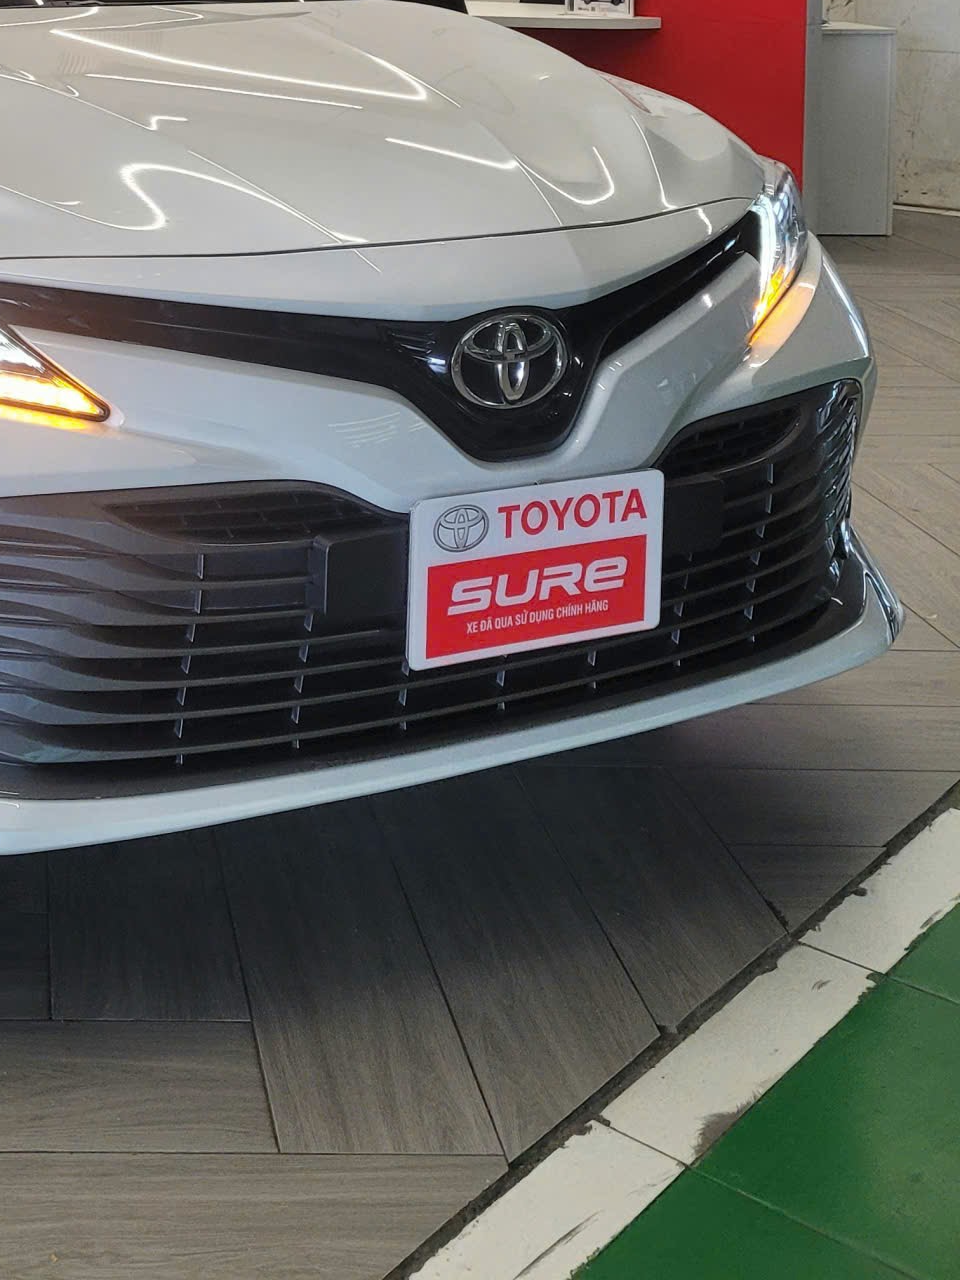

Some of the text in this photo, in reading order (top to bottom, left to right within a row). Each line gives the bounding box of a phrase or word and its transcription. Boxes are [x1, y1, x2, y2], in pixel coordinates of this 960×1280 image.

[497, 488, 648, 539] TOYOTA
[466, 599, 609, 634] XE ĐÃ QUA SỬ DỤNG CHÍNH HÃNG
